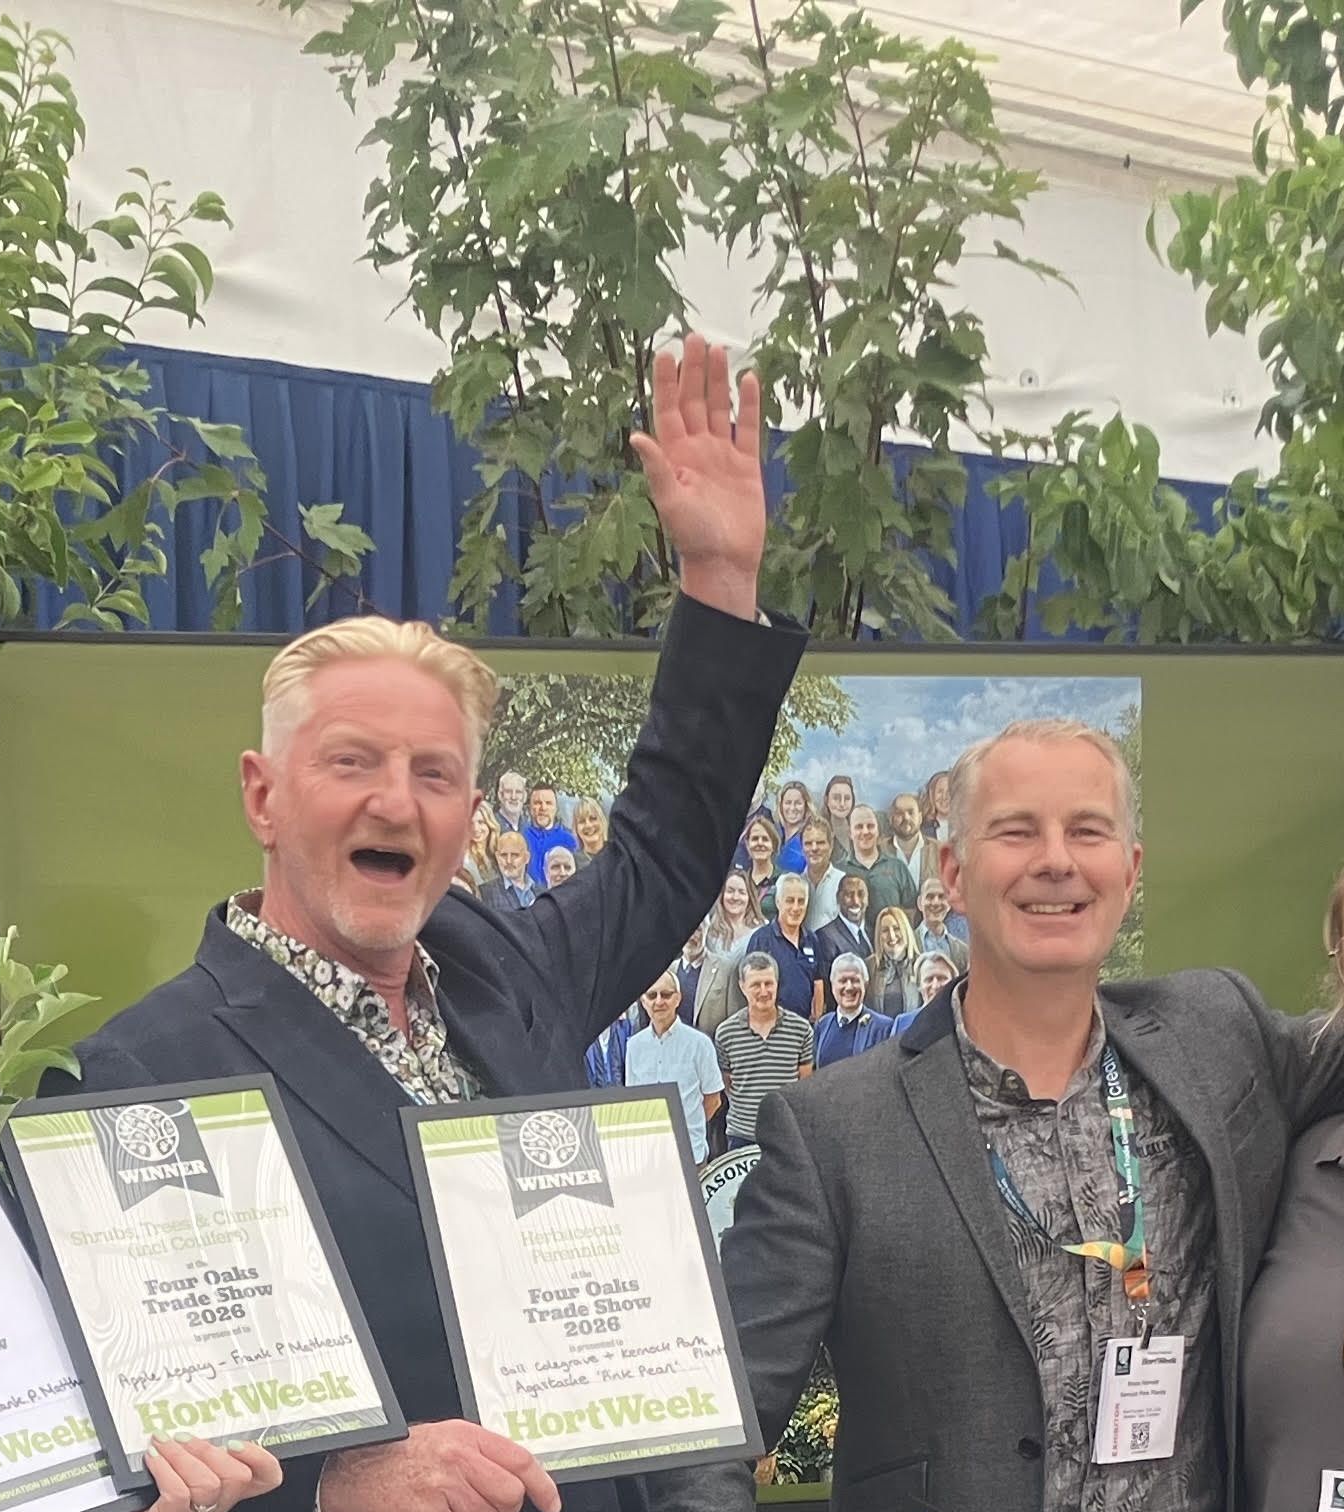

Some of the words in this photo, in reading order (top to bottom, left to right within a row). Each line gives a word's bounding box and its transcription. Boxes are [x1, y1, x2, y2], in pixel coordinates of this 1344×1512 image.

[117, 1158, 208, 1184] WINNER
[516, 1168, 603, 1192] WINNER
[705, 1159, 758, 1204] ASON
[68, 1222, 140, 1248] Shrubs,
[138, 1216, 192, 1237] Trees
[142, 1272, 200, 1296] Four
[201, 1263, 260, 1286] Oaks
[527, 1283, 581, 1304] Four
[583, 1275, 640, 1297] Oaks
[141, 1290, 212, 1316] Trade
[212, 1279, 275, 1304] Show
[522, 1300, 590, 1324] Trade
[592, 1292, 653, 1315] Show
[183, 1302, 248, 1328] 2026
[562, 1314, 622, 1338] 2026
[116, 1367, 164, 1394] Apple
[162, 1358, 218, 1386] Legacy
[229, 1344, 273, 1366] Frank
[132, 1366, 357, 1435] HortWeek
[502, 1382, 720, 1444] HortWeek
